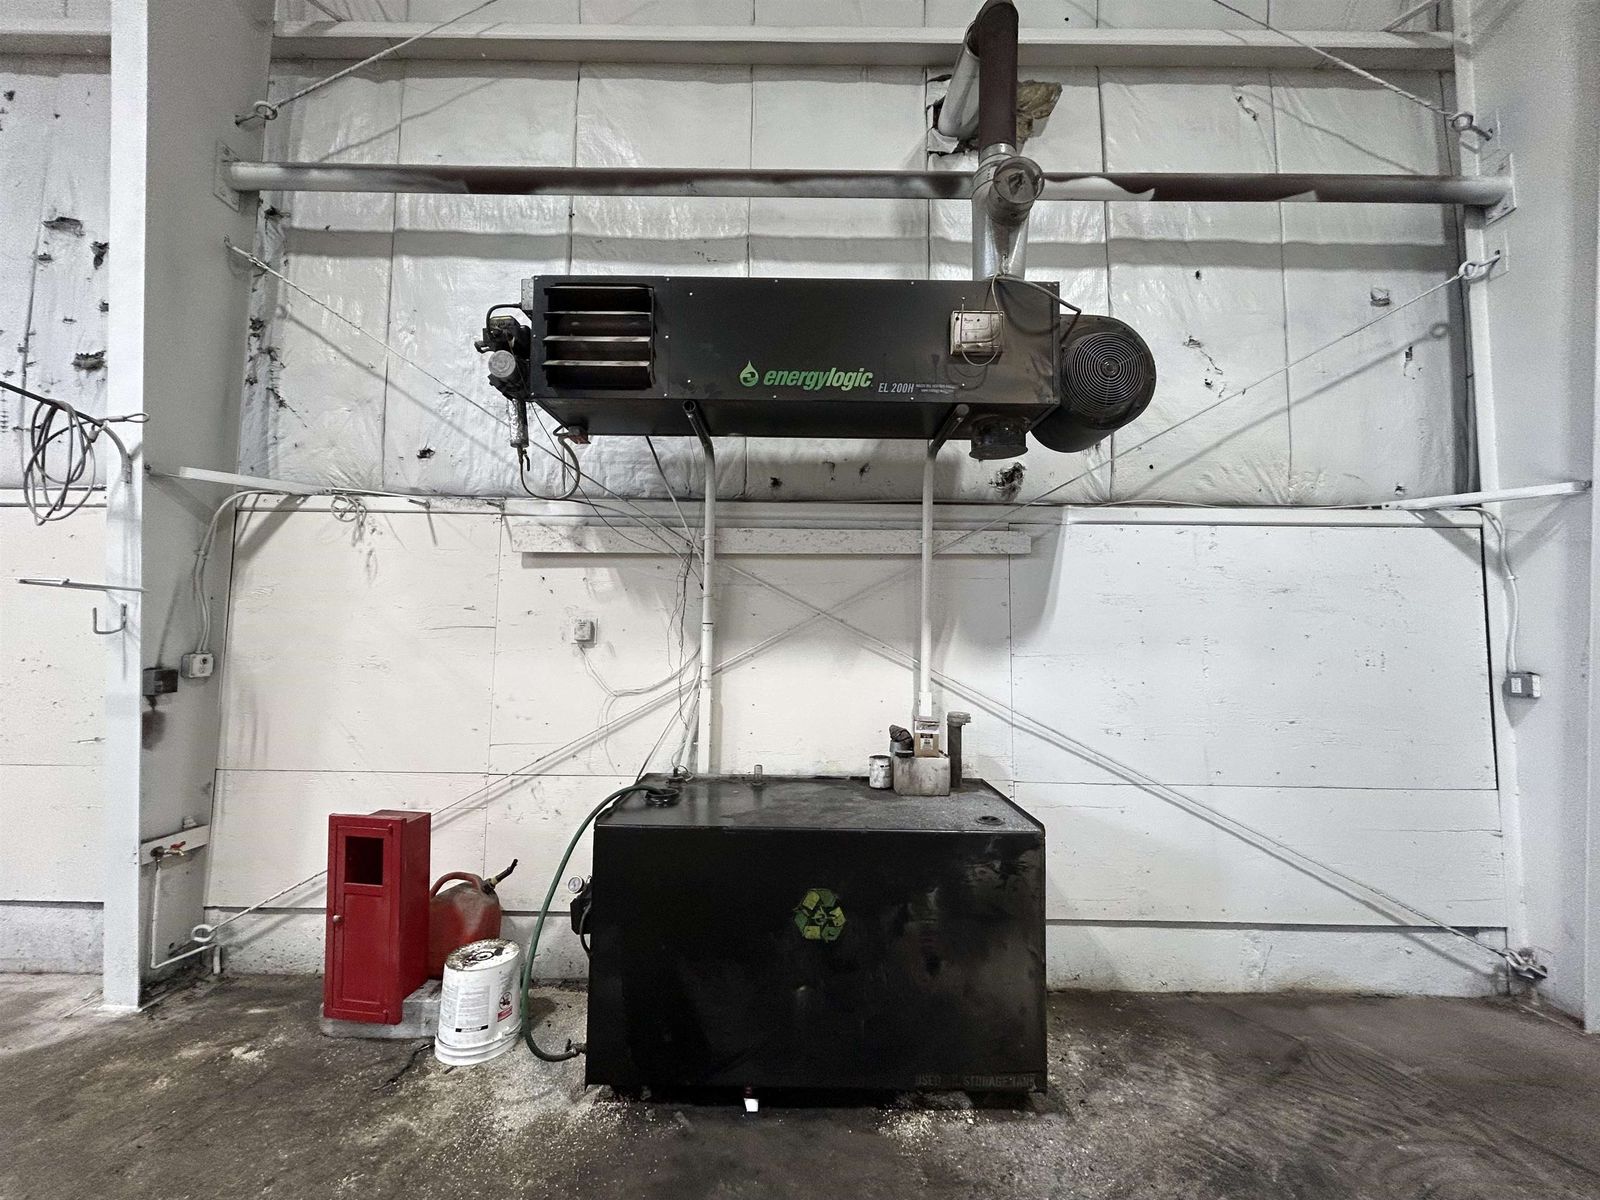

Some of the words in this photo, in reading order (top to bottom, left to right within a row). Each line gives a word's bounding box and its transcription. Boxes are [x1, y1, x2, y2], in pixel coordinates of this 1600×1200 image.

[763, 368, 874, 391] energylogic
[878, 382, 889, 393] EL
[891, 382, 915, 393] 200H
